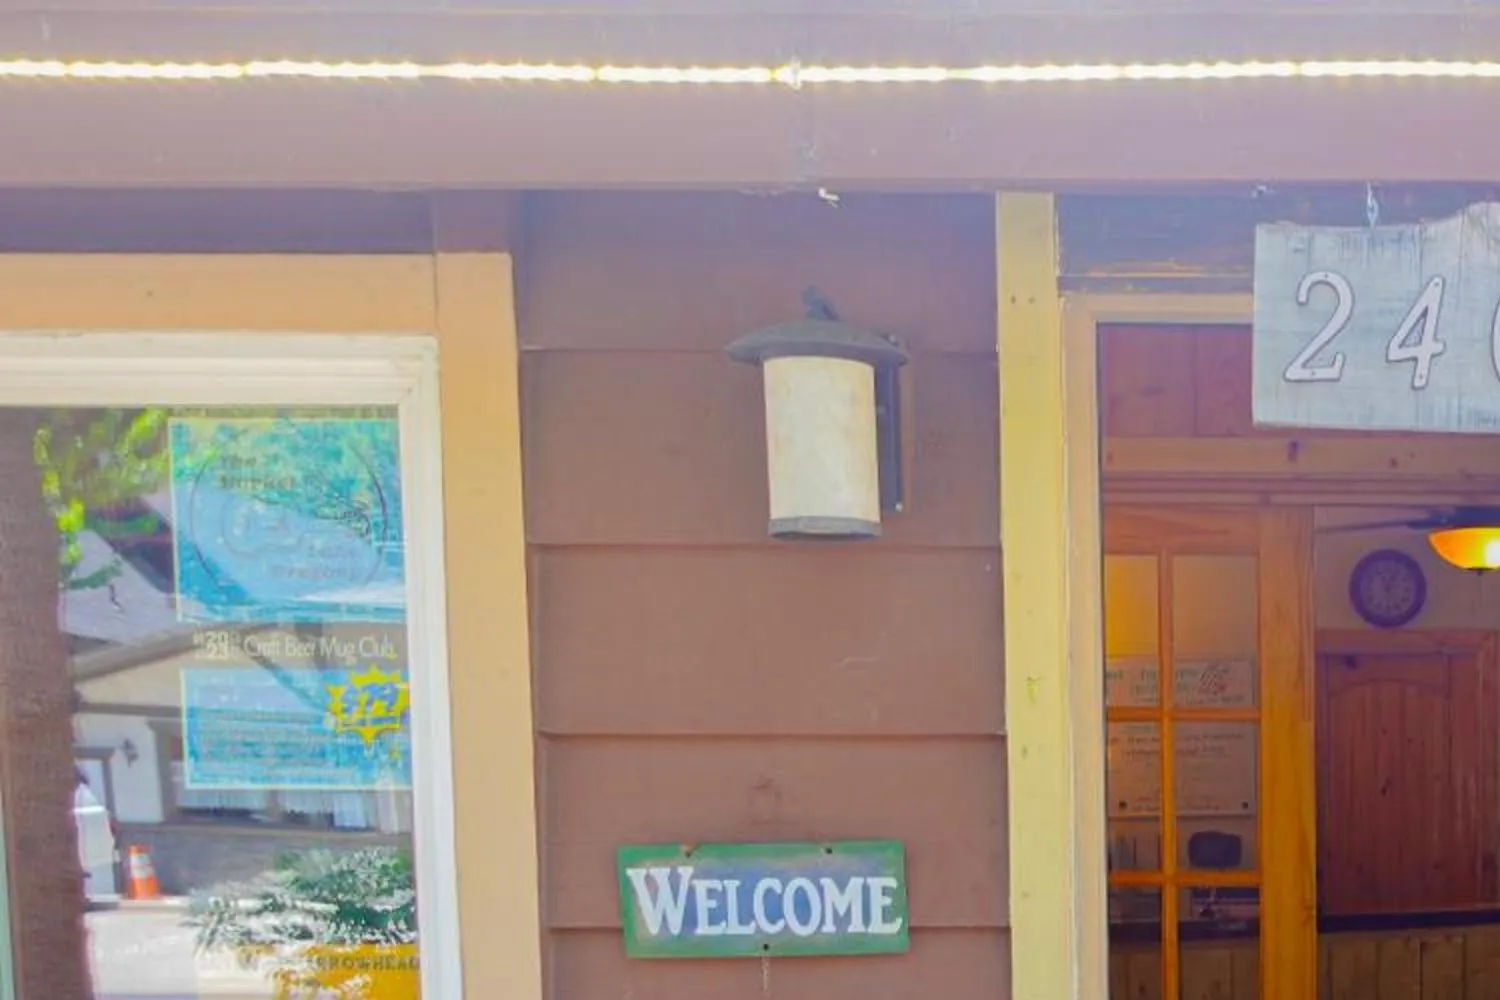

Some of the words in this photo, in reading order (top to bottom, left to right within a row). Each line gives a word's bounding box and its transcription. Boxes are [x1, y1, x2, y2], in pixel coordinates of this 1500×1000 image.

[285, 636, 316, 657] Beer
[320, 636, 355, 664] Mug
[359, 634, 394, 658] Club
[625, 866, 902, 937] WELCOME
